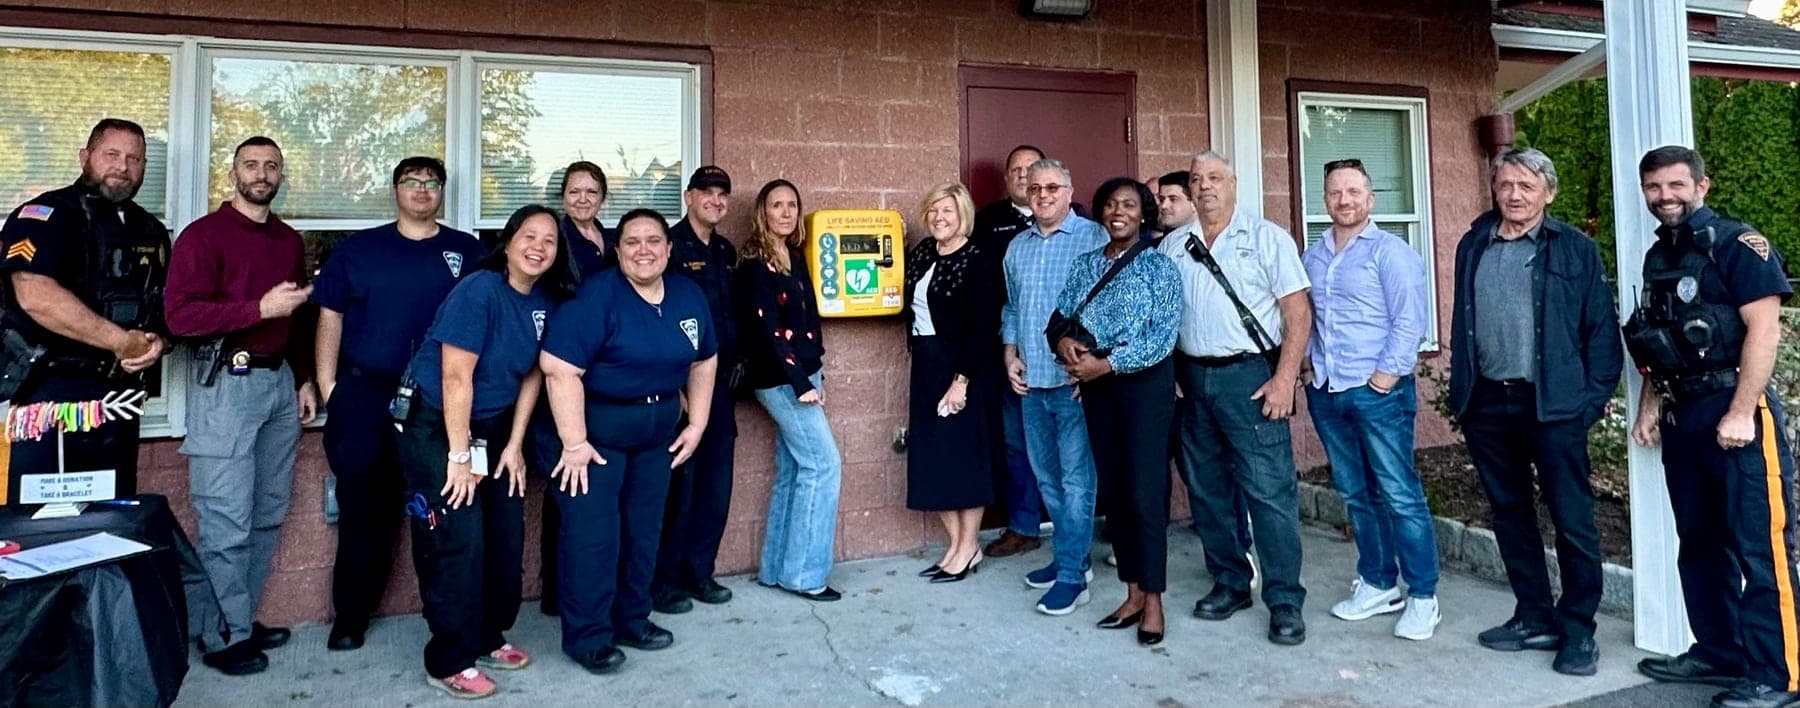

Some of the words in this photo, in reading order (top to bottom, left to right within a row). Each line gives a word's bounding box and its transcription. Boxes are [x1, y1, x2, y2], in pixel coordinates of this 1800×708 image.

[826, 217, 843, 225] LIFE
[875, 215, 890, 224] AED
[62, 490, 92, 498] BRACELET
